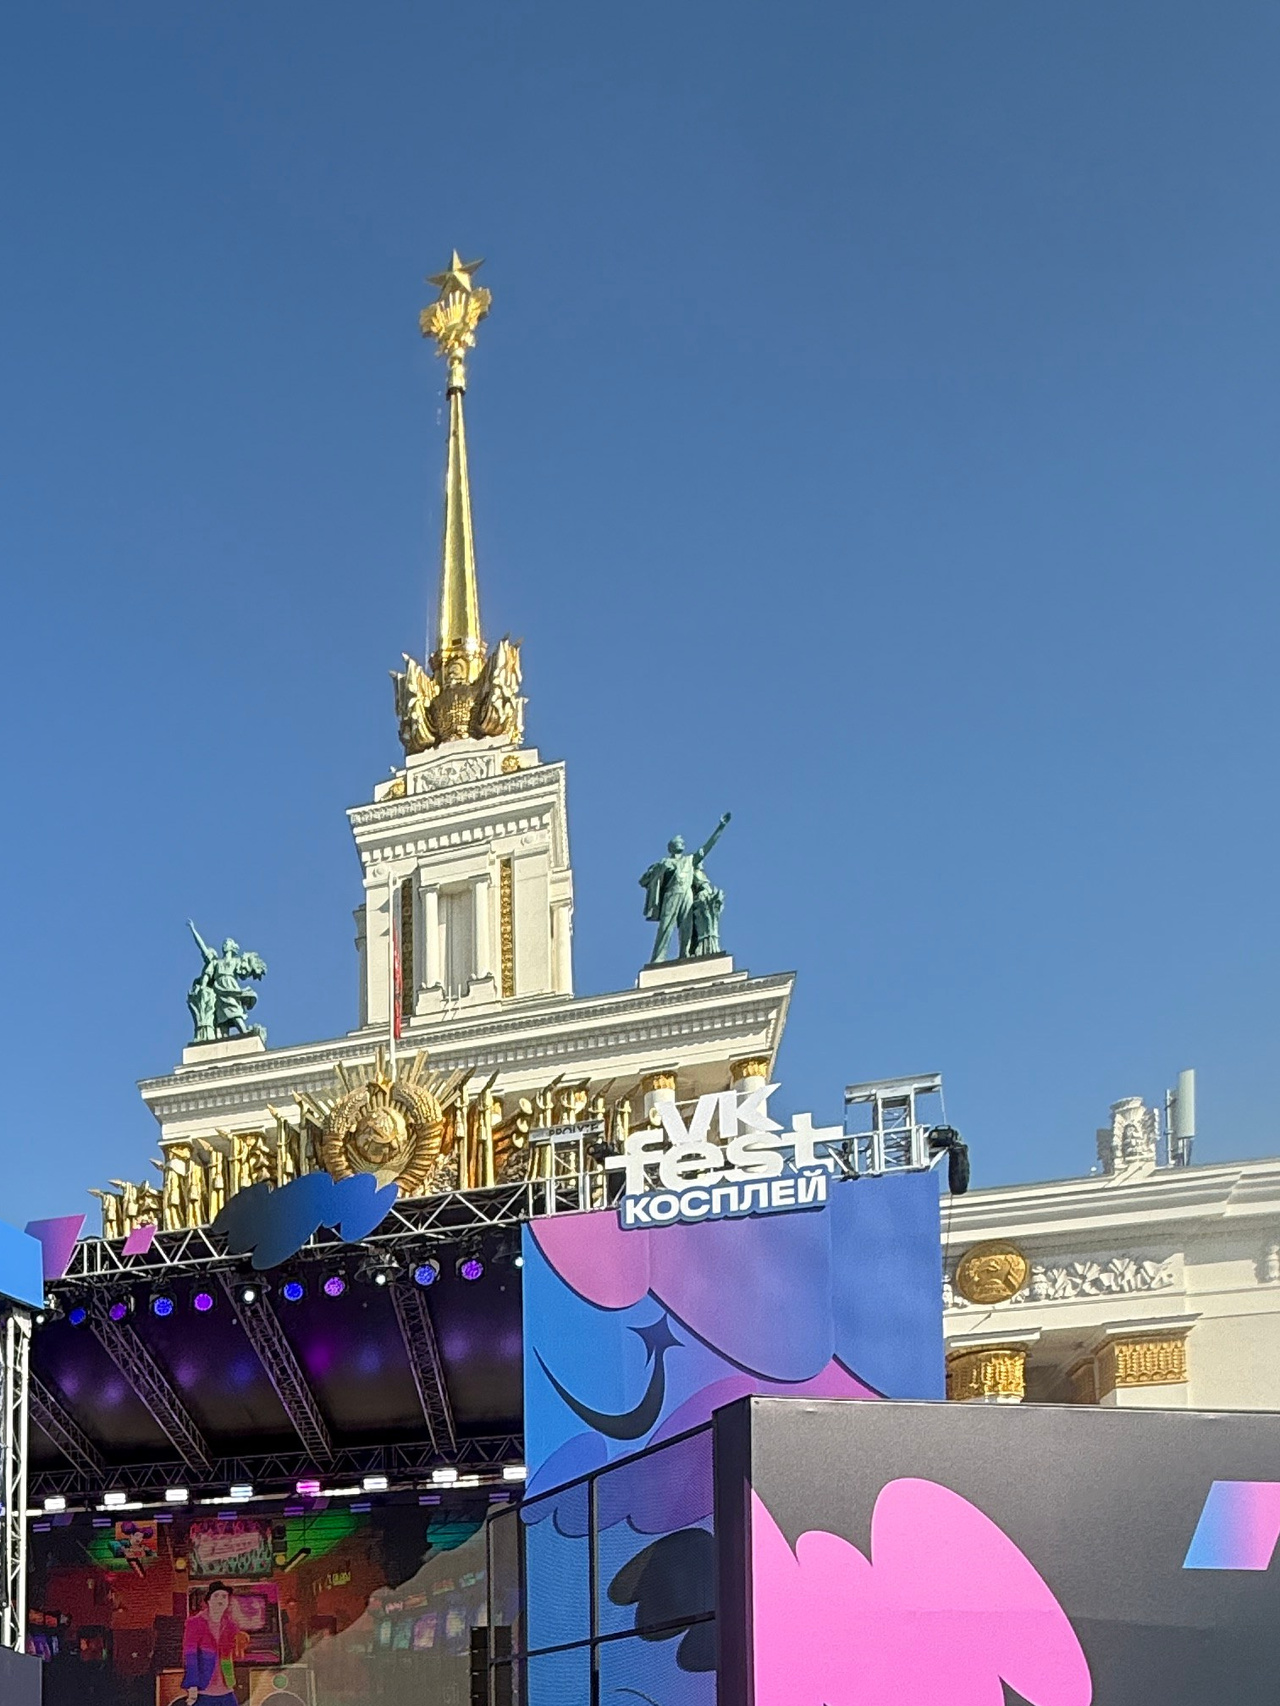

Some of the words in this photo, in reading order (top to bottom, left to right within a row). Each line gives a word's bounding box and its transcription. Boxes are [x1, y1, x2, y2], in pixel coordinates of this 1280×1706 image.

[654, 1083, 784, 1146] VK
[605, 1113, 844, 1195] fest
[625, 1169, 827, 1224] КОСПЛЕЙ
